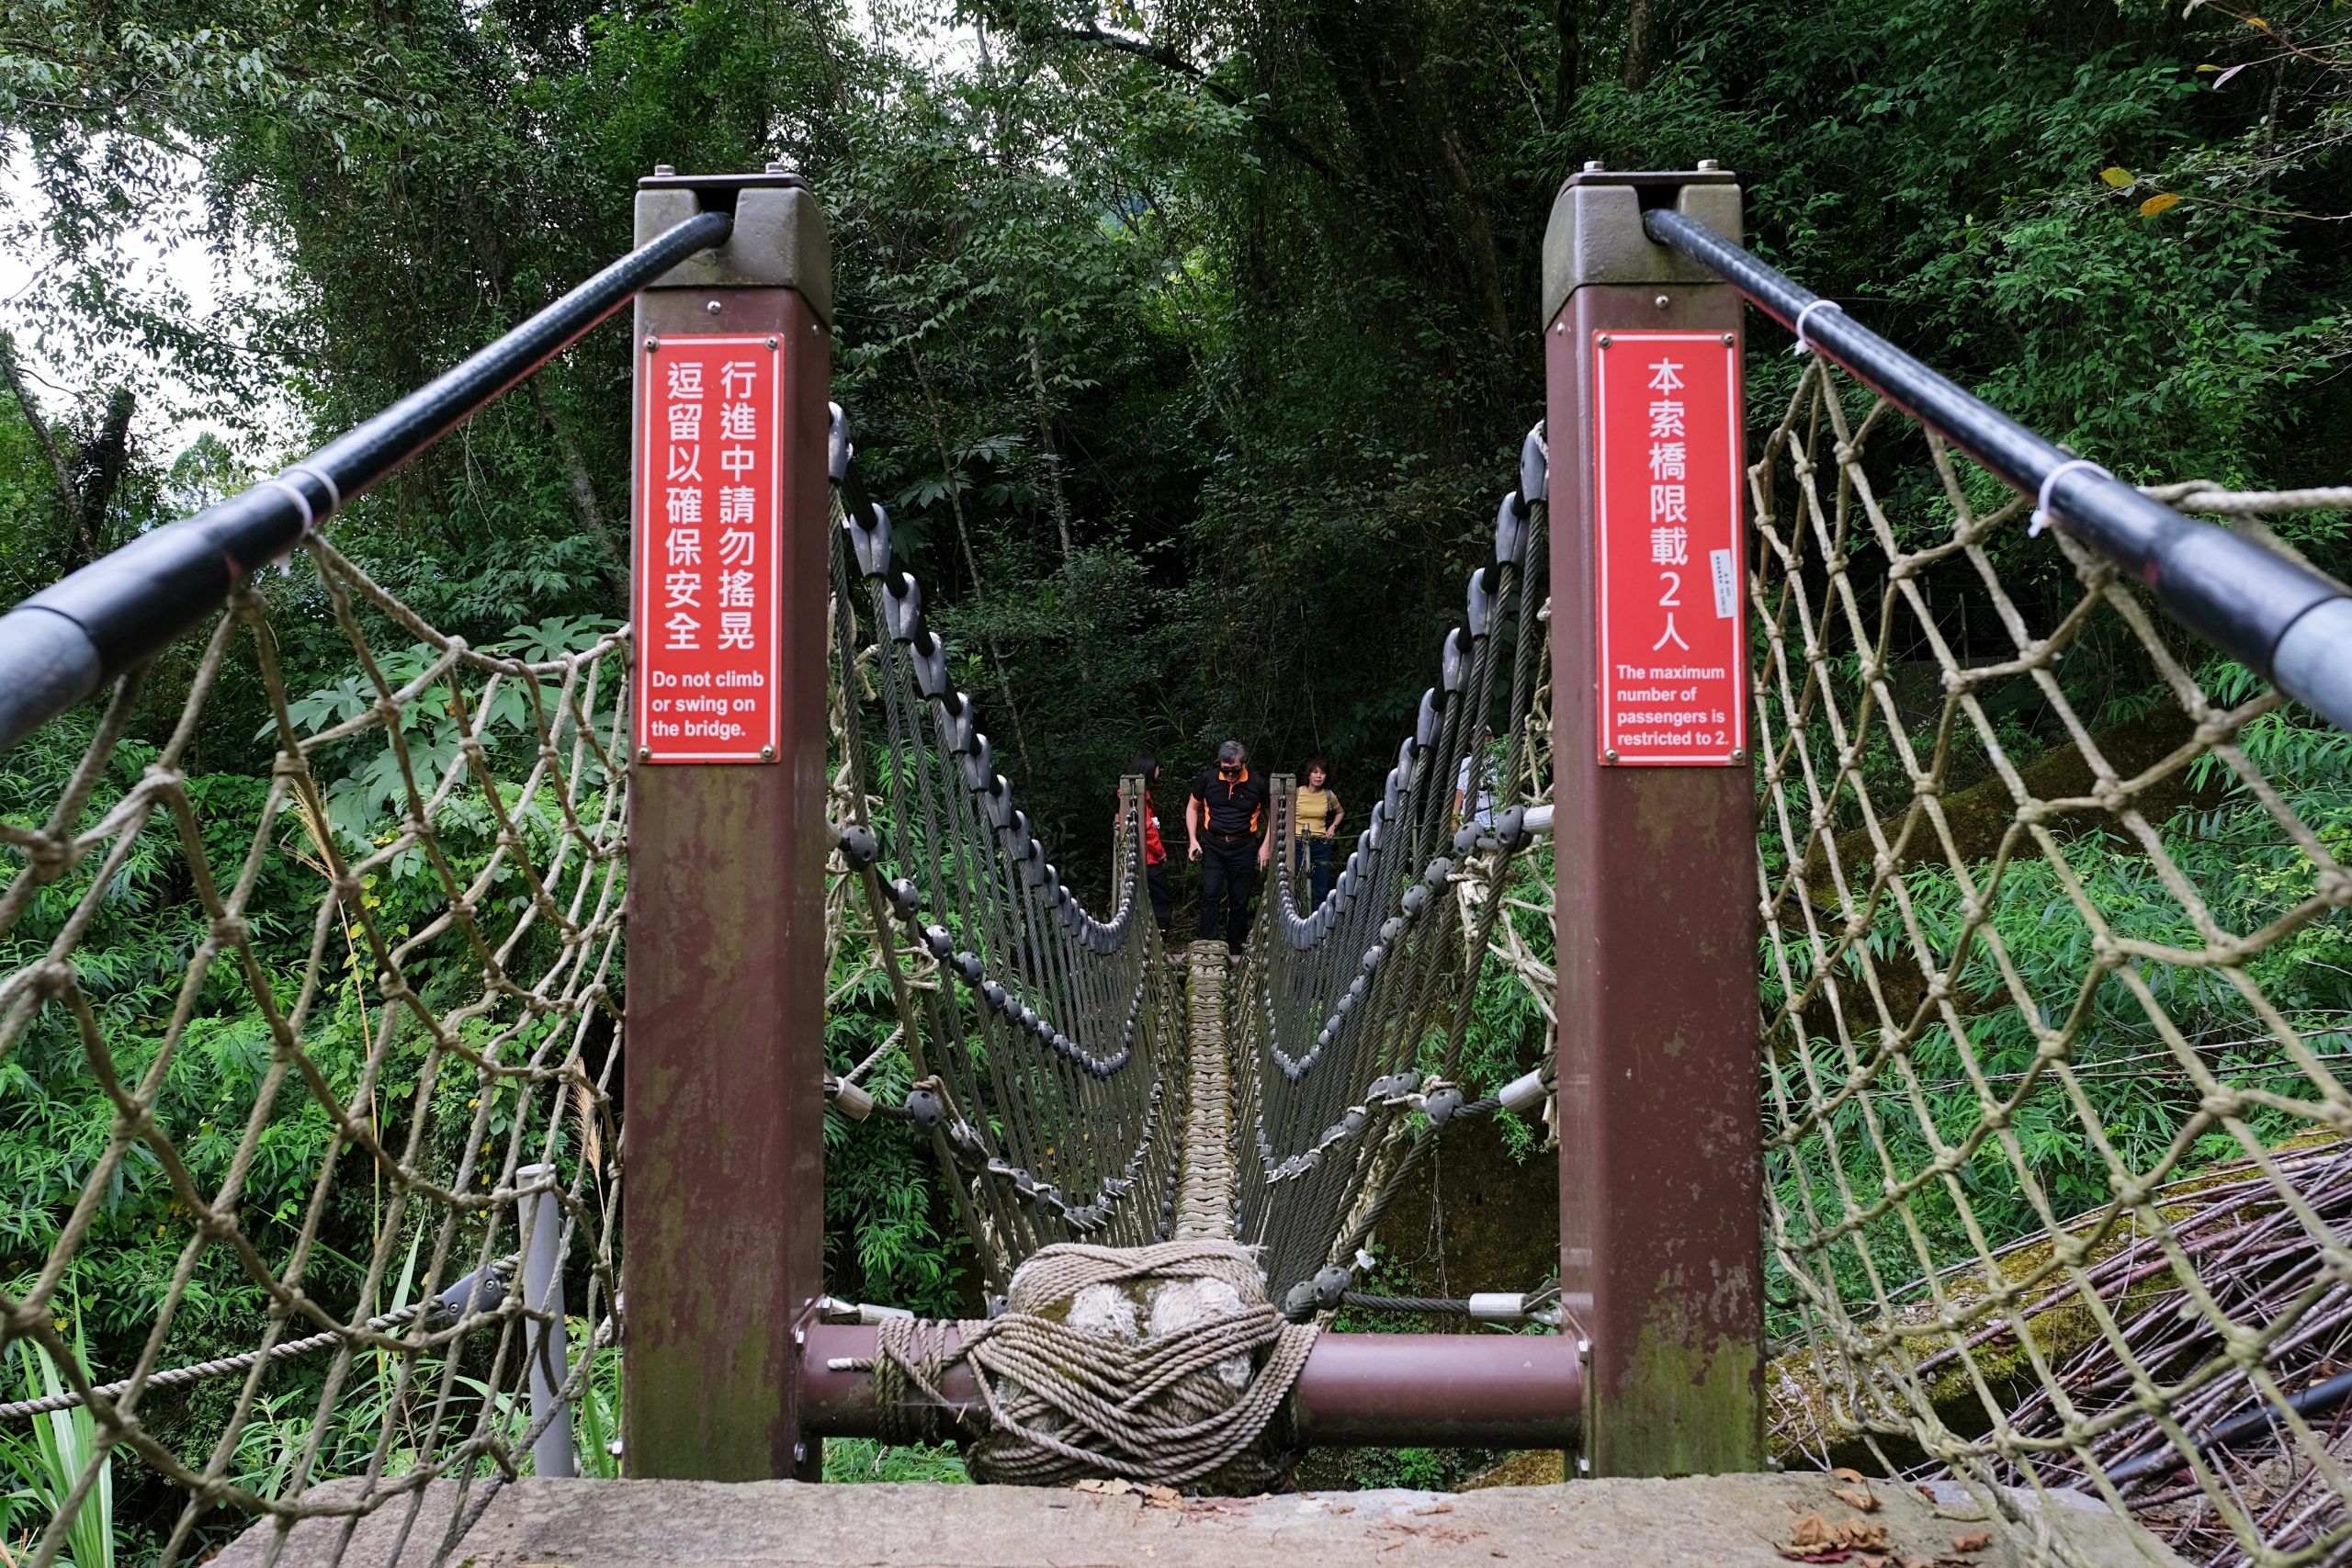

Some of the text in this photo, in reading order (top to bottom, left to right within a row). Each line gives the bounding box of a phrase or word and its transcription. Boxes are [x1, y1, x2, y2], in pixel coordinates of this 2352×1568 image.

[664, 361, 704, 649] 逗留以確保安全
[718, 360, 757, 650] 行進中請勿搖晃
[1647, 357, 1690, 651] 本索橋限載2人
[652, 670, 764, 687] Do not climb
[1616, 664, 1725, 680] The maximum
[1617, 686, 1697, 702] number of
[651, 694, 756, 716] or swing on
[1617, 708, 1725, 728] passengers is
[651, 719, 746, 740] the bridge.
[1617, 730, 1730, 746] restricted to 2.
